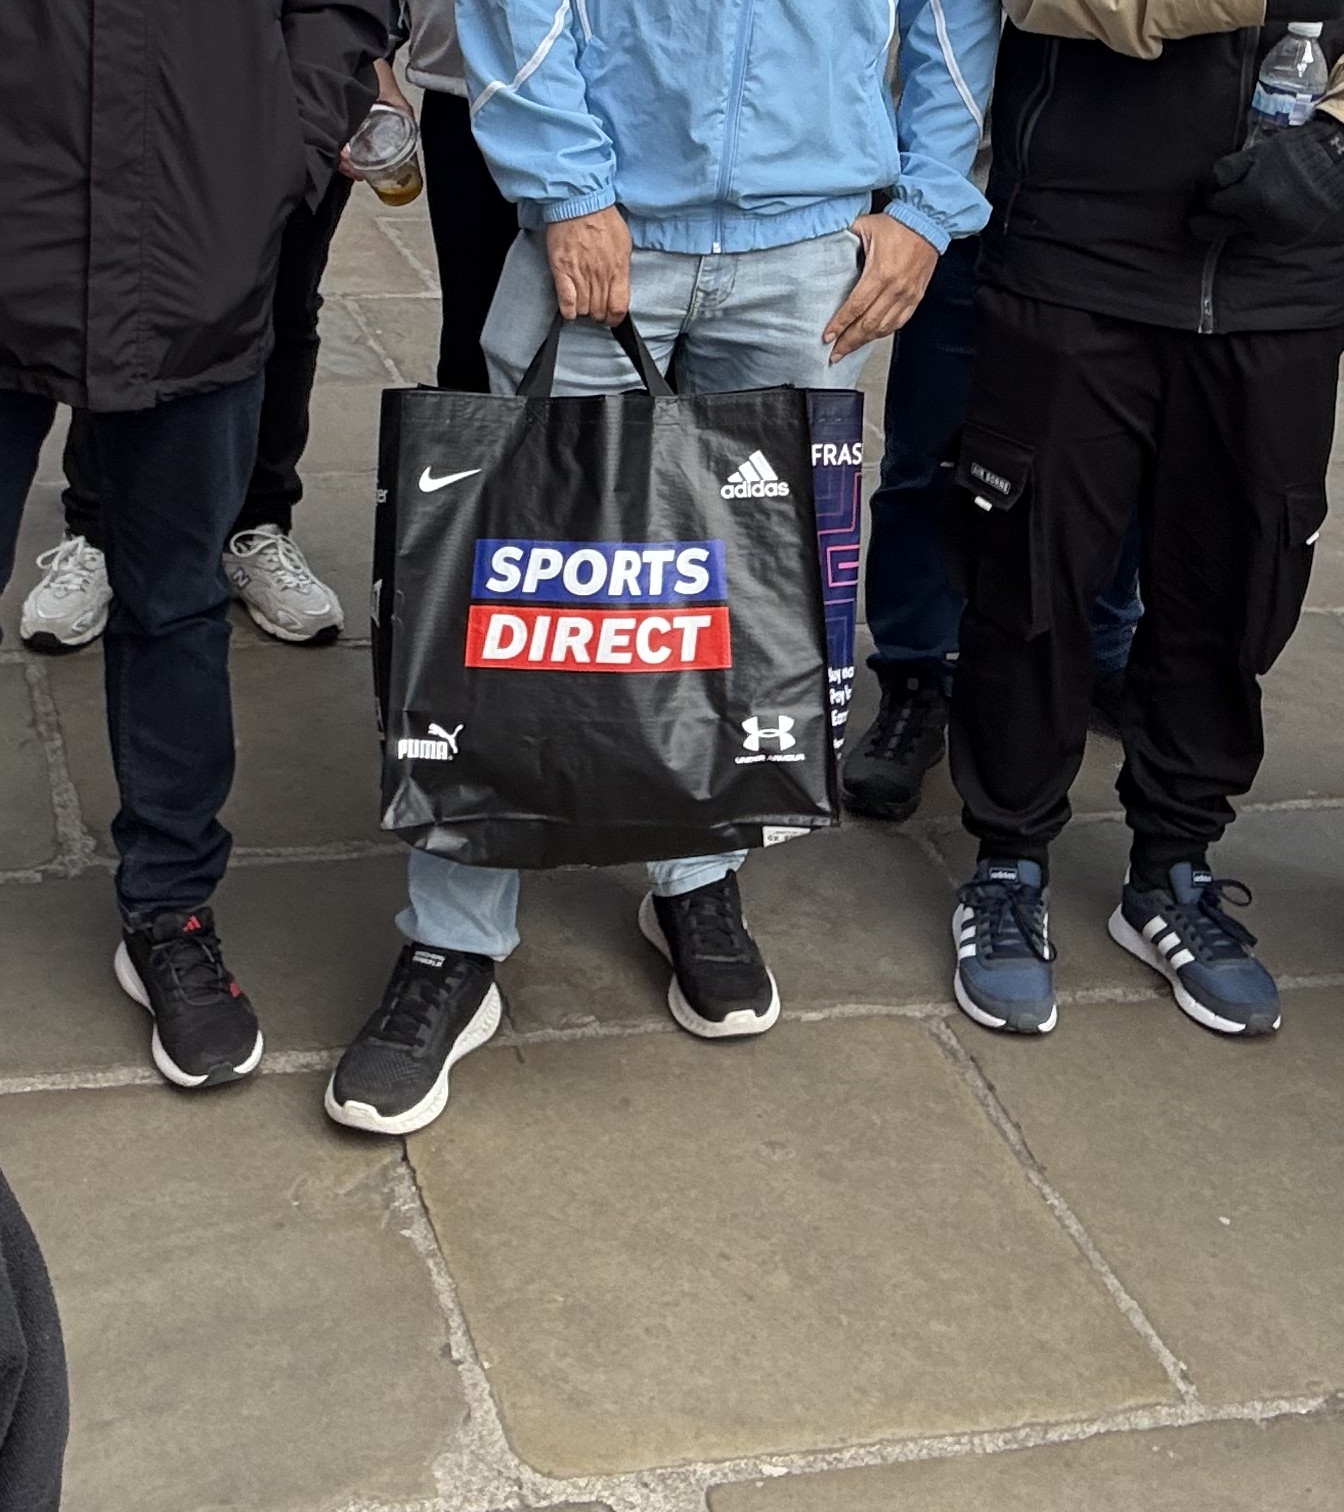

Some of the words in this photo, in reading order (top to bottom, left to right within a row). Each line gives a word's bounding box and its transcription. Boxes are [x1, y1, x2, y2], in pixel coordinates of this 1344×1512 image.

[720, 480, 790, 499] adidas
[485, 546, 710, 597] SPORTS
[481, 614, 712, 665] DIRECT
[397, 738, 448, 760] PUMA
